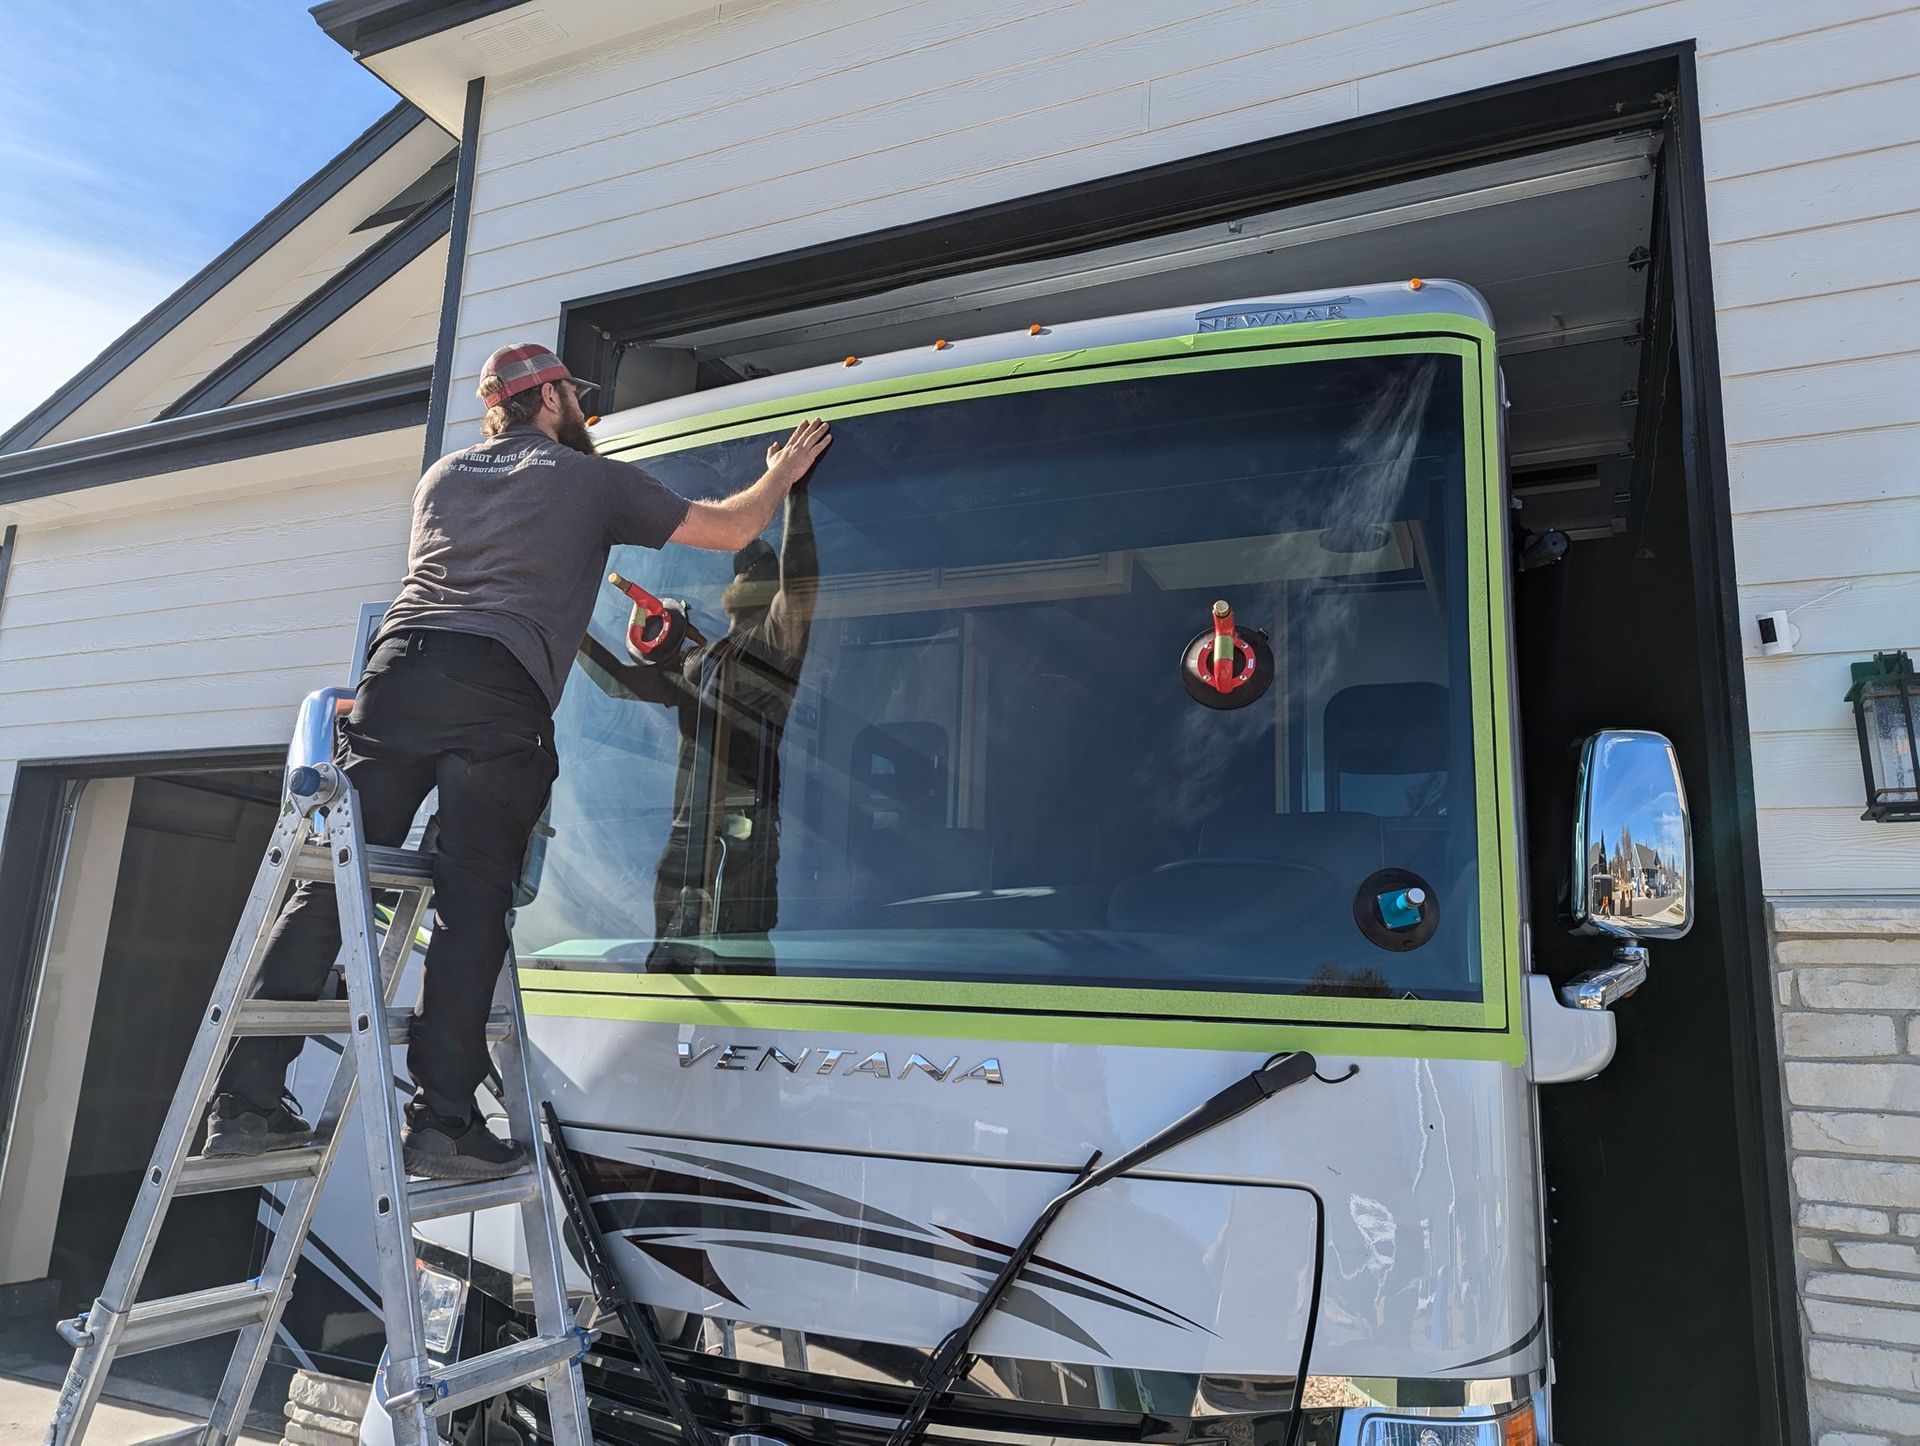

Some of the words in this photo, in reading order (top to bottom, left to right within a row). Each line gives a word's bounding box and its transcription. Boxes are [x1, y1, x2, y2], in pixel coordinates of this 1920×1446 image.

[1197, 306, 1347, 333] NEWMAR
[455, 452, 492, 463] ATRIOT
[677, 1042, 1003, 1085] VENTANA
